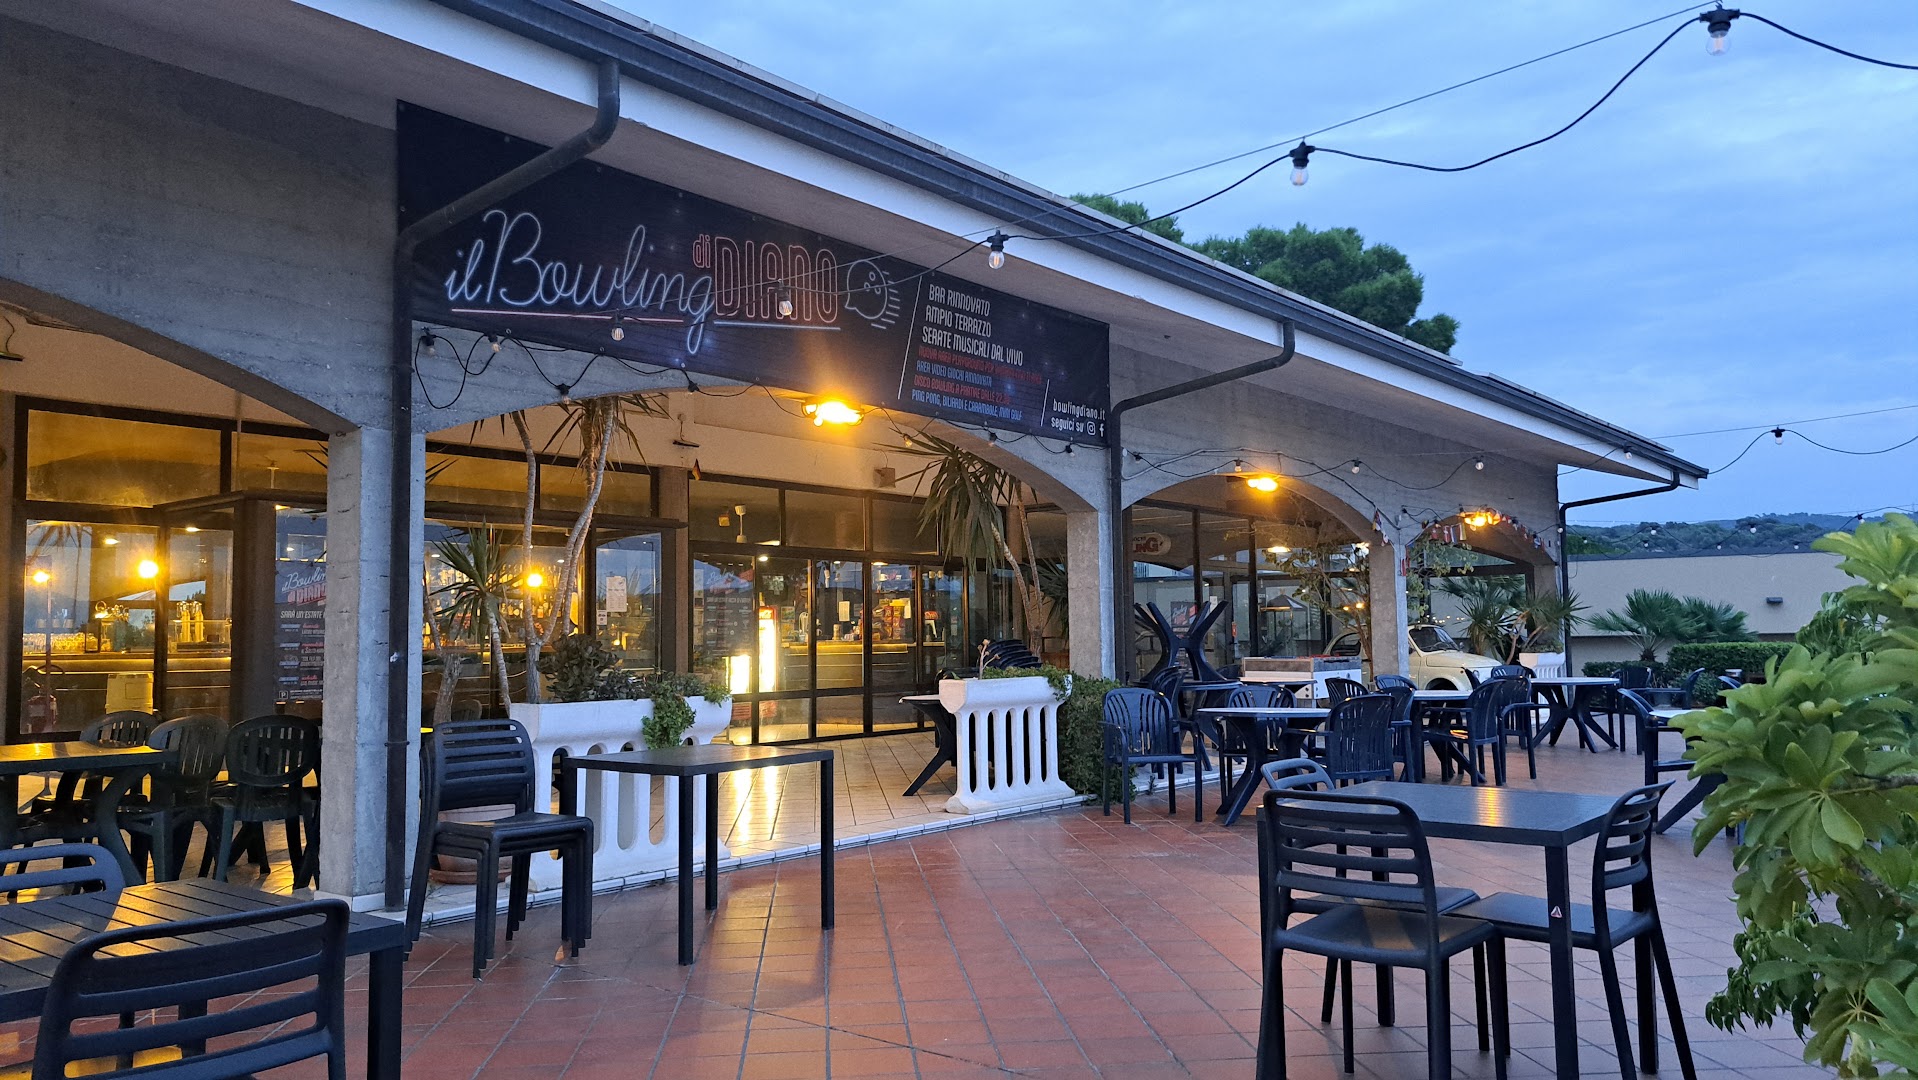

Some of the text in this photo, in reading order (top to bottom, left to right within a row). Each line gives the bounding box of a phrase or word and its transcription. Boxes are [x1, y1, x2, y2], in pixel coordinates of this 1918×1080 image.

[445, 209, 715, 355] il Bowling
[692, 233, 838, 324] di DIANO
[929, 284, 990, 317] BAR RINNOVATO
[925, 304, 992, 338] AMPIO TERRAZZO
[922, 325, 1024, 367] SERATE MUSICALI DAL VIVO
[914, 374, 931, 388] DISCO
[931, 378, 955, 394] BOWLING
[916, 359, 931, 373] AREA
[931, 362, 947, 377] VIDEO
[911, 388, 925, 403] PING
[925, 391, 942, 407] PONG,
[942, 395, 964, 410] BILIARDI
[964, 399, 968, 411] E
[1010, 408, 1022, 421] GOLF
[1053, 398, 1106, 421] bowlingdiano.it
[1051, 416, 1075, 431] seguici
[1075, 421, 1084, 433] su
[287, 566, 326, 590] Bowlin
